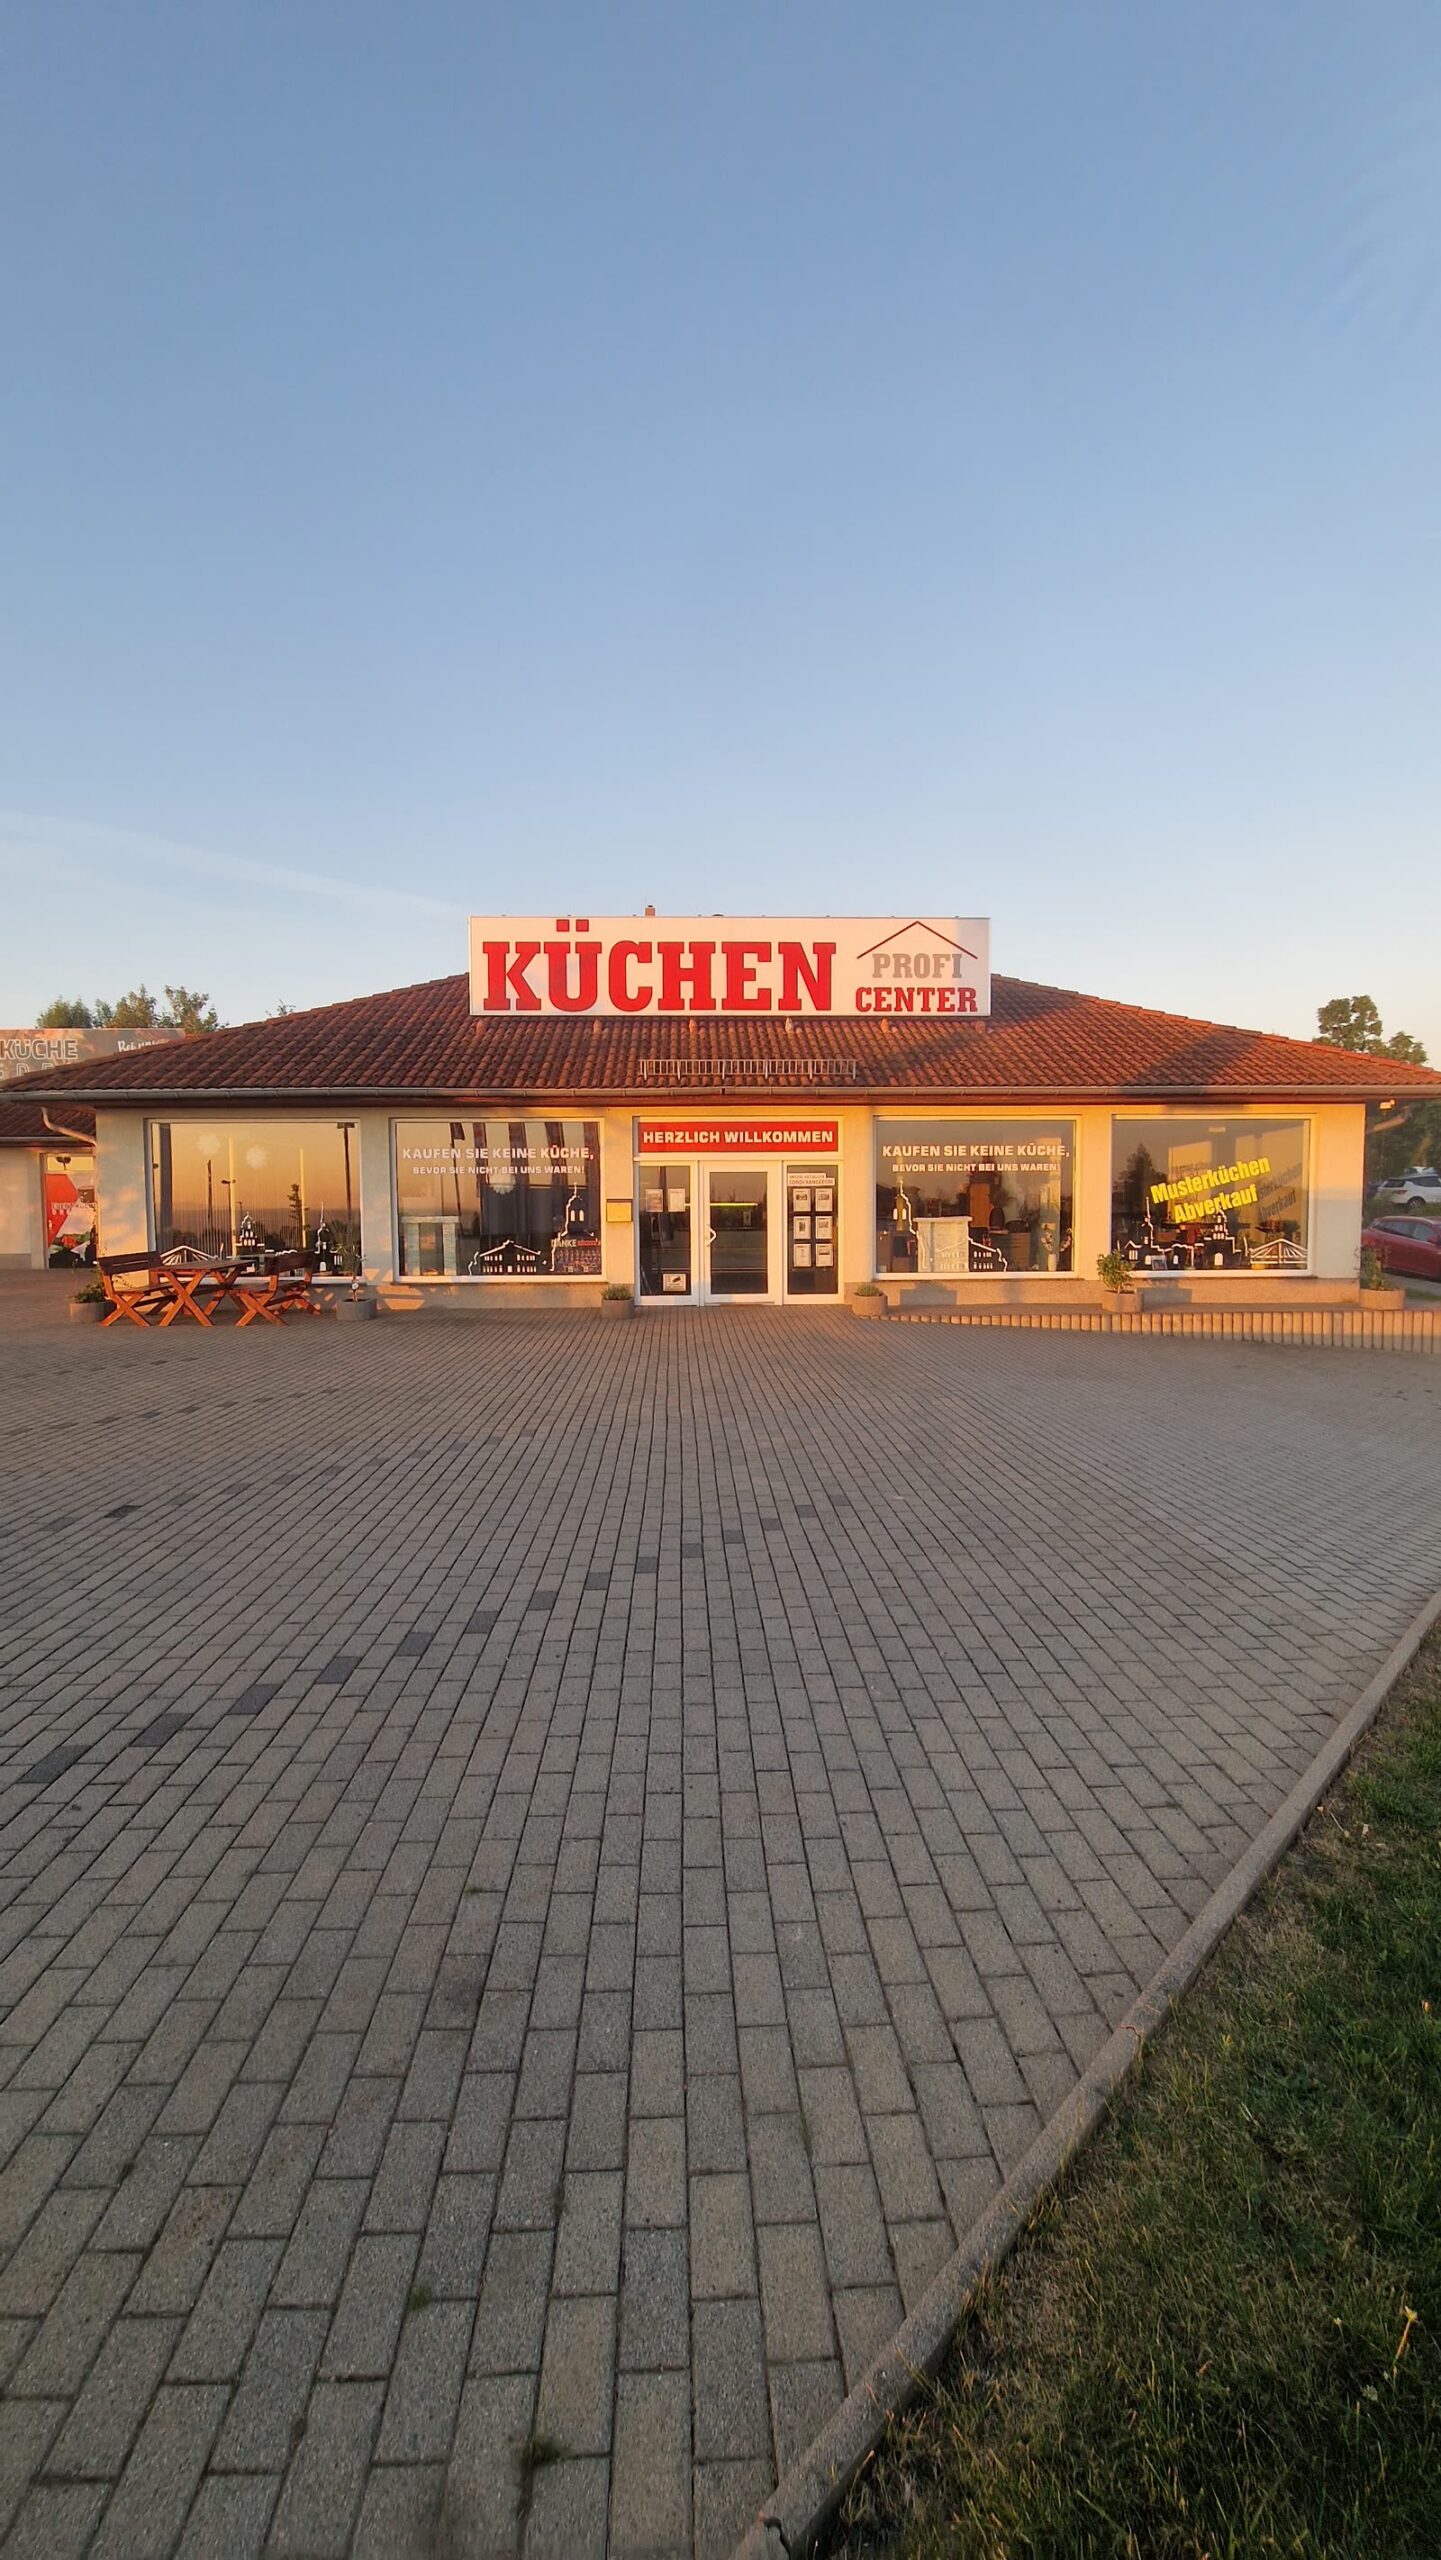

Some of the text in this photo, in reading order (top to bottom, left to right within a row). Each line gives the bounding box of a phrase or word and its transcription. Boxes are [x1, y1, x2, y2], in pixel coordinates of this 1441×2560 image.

[483, 919, 836, 1012] KÜCHEN
[872, 953, 963, 979] PROFI
[855, 986, 978, 1012] CENTER
[643, 1130, 833, 1144] HERZLICH WILLKOMMEN
[402, 1144, 594, 1160] KAUFEN SIE KEINE KÜCHE,
[882, 1142, 1070, 1157] KAUFEN SIE KEINE KÜCHE,
[413, 1165, 585, 1175] BEVOR SIE NICHT BEI UNS WAREN!
[892, 1164, 926, 1172] BEVOR
[927, 1164, 944, 1172] SIE
[946, 1163, 977, 1172] NICHT
[978, 1163, 995, 1172] BEI
[997, 1163, 1018, 1172] UNS
[1150, 1157, 1271, 1204] Musterküchen
[1174, 1183, 1258, 1223] Abverkauf
